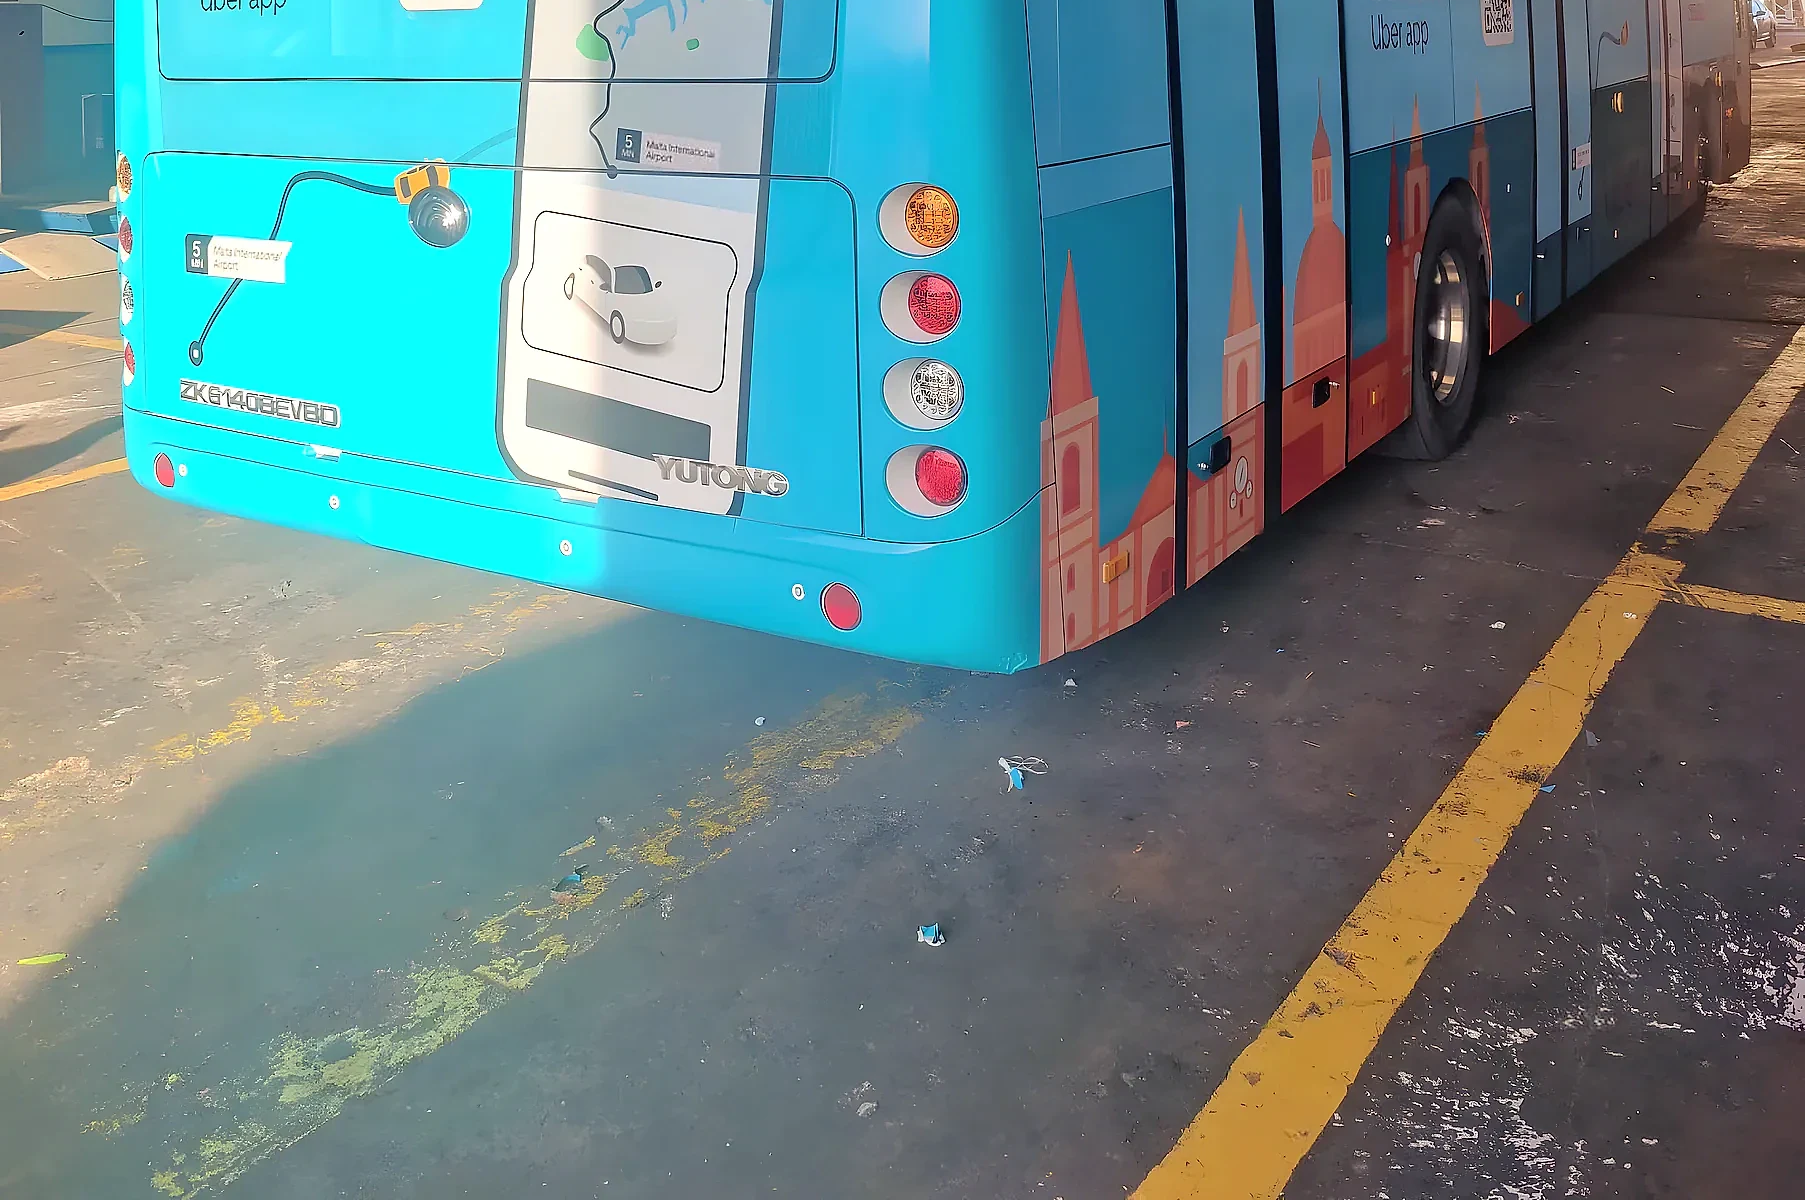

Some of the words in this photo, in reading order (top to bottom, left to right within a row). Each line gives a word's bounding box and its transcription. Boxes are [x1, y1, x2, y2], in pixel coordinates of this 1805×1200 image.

[1371, 13, 1403, 51] Uber
[1406, 20, 1429, 55] app
[624, 134, 633, 149] 5
[192, 240, 202, 258] 5
[651, 454, 789, 497] YUTONG
